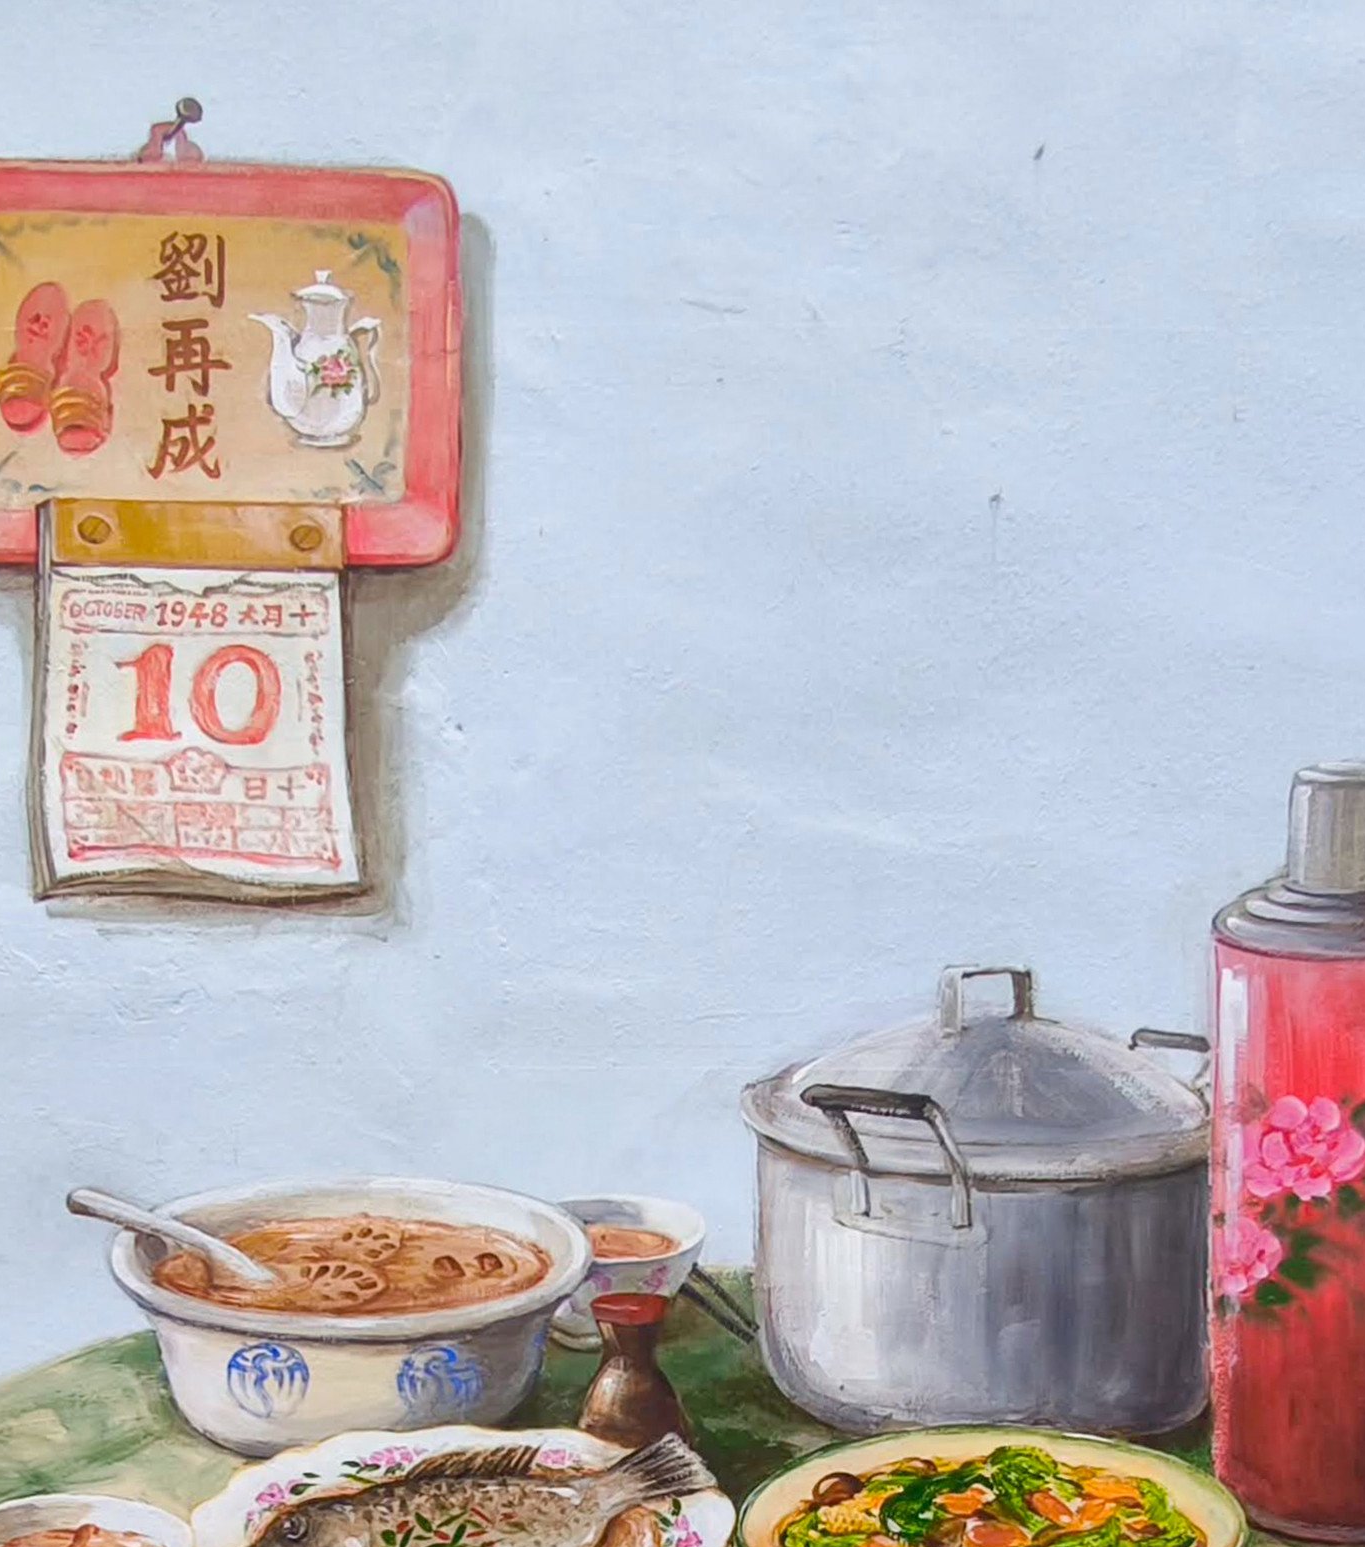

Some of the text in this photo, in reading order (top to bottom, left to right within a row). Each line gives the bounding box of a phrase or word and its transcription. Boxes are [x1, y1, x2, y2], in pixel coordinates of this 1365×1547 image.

[147, 230, 233, 480] 劉再成
[154, 601, 229, 628] 1948
[114, 643, 281, 744] 10
